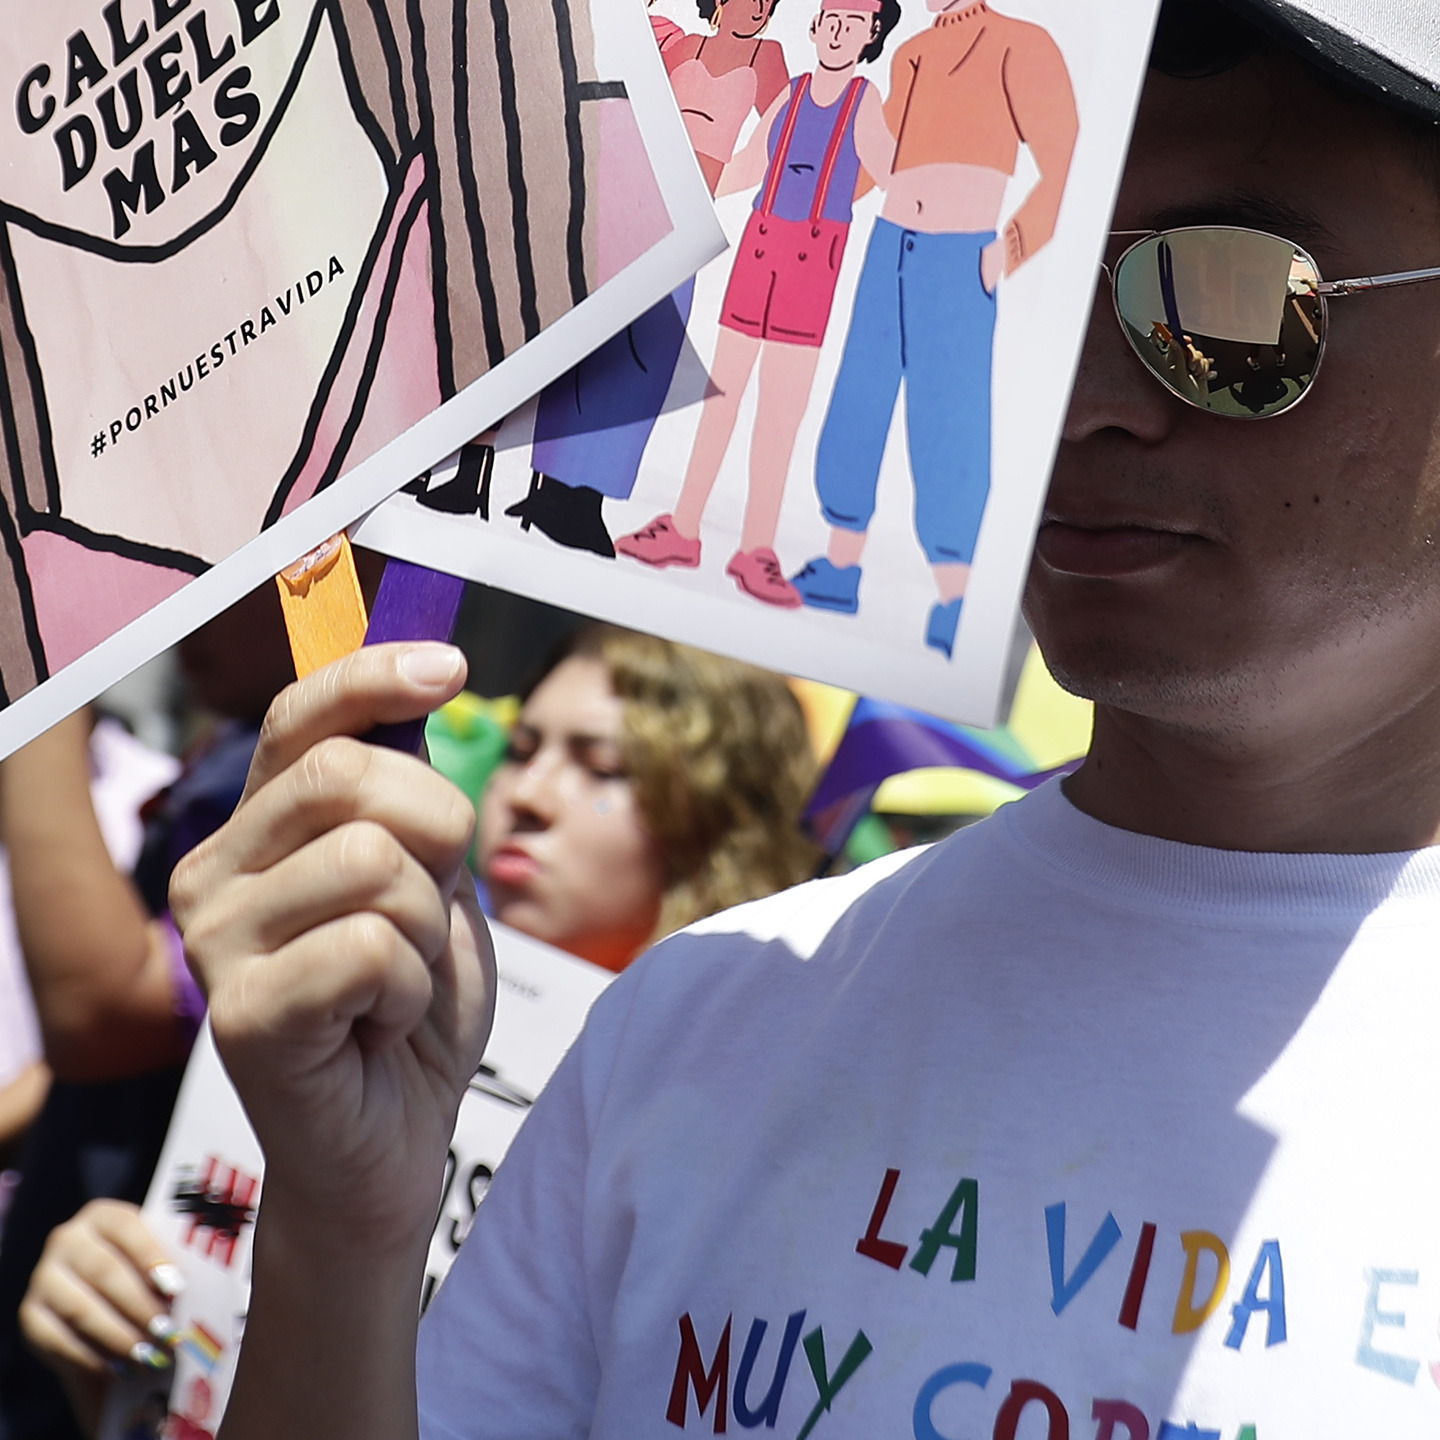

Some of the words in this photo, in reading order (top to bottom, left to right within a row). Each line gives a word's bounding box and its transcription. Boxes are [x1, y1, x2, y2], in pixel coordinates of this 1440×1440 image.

[101, 65, 262, 240] MÁS
[89, 254, 347, 459] #PORNUESTRAVIDA
[855, 1167, 979, 1283] LA
[1044, 1200, 1288, 1350] VIDA
[665, 1308, 874, 1440] MUY
